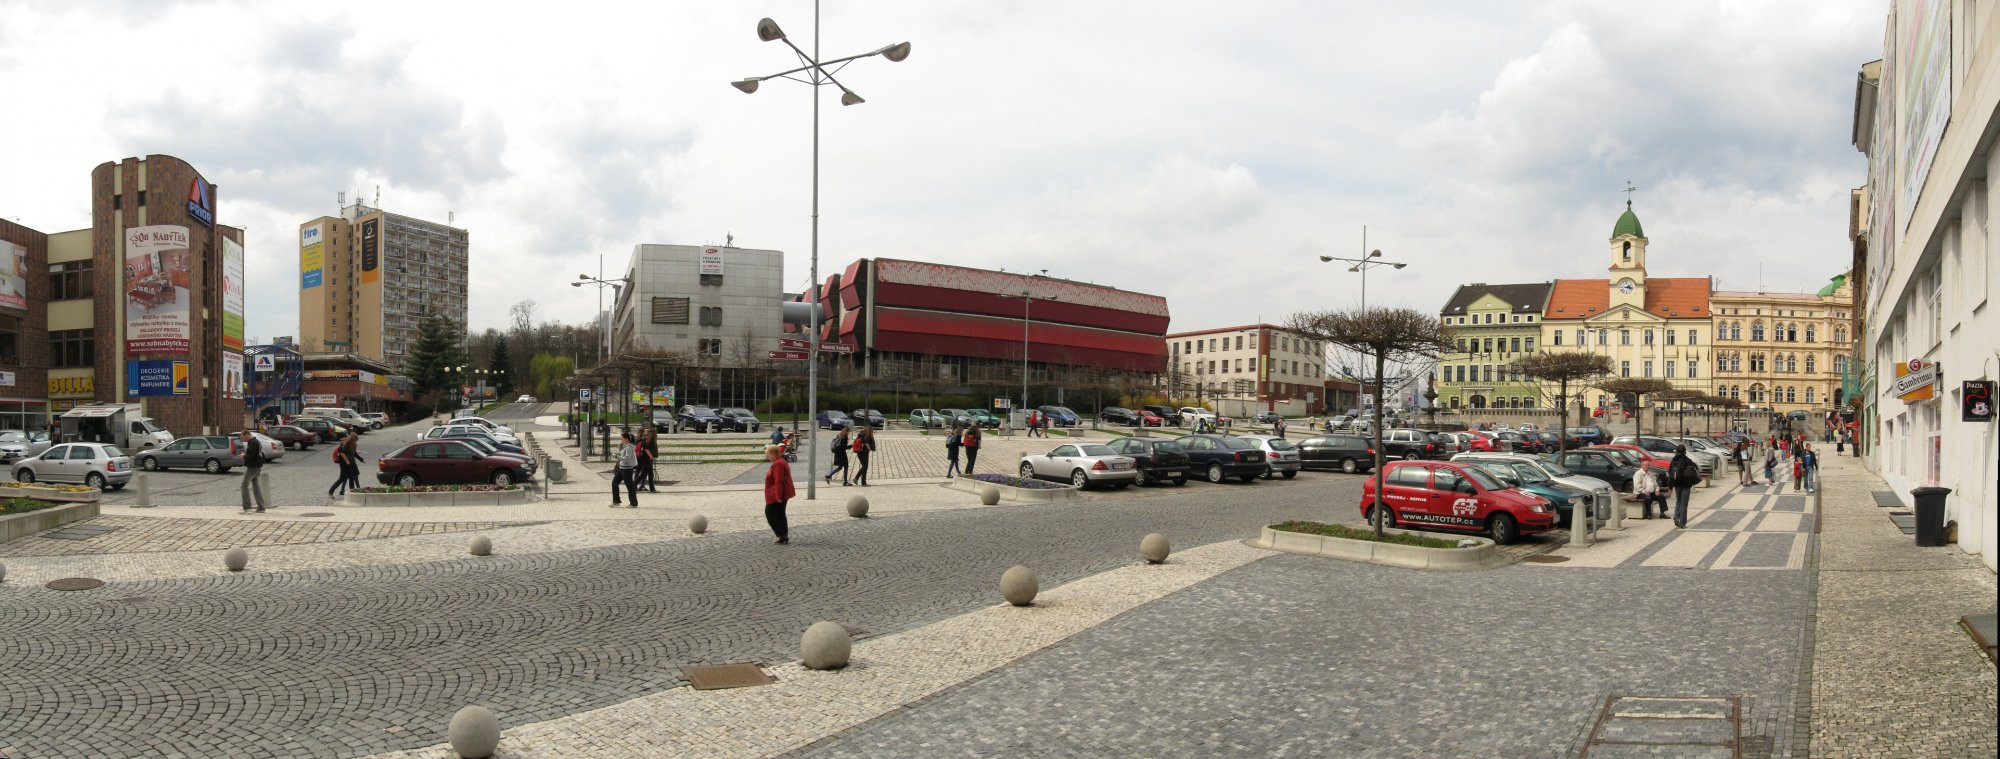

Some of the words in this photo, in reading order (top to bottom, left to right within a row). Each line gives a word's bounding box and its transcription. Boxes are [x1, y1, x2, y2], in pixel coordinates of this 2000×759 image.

[188, 200, 212, 225] PRIOR
[48, 377, 95, 394] BILLA
[1897, 373, 1933, 392] Gambrinus
[1402, 513, 1475, 526] www.AUTOTEP.cz
